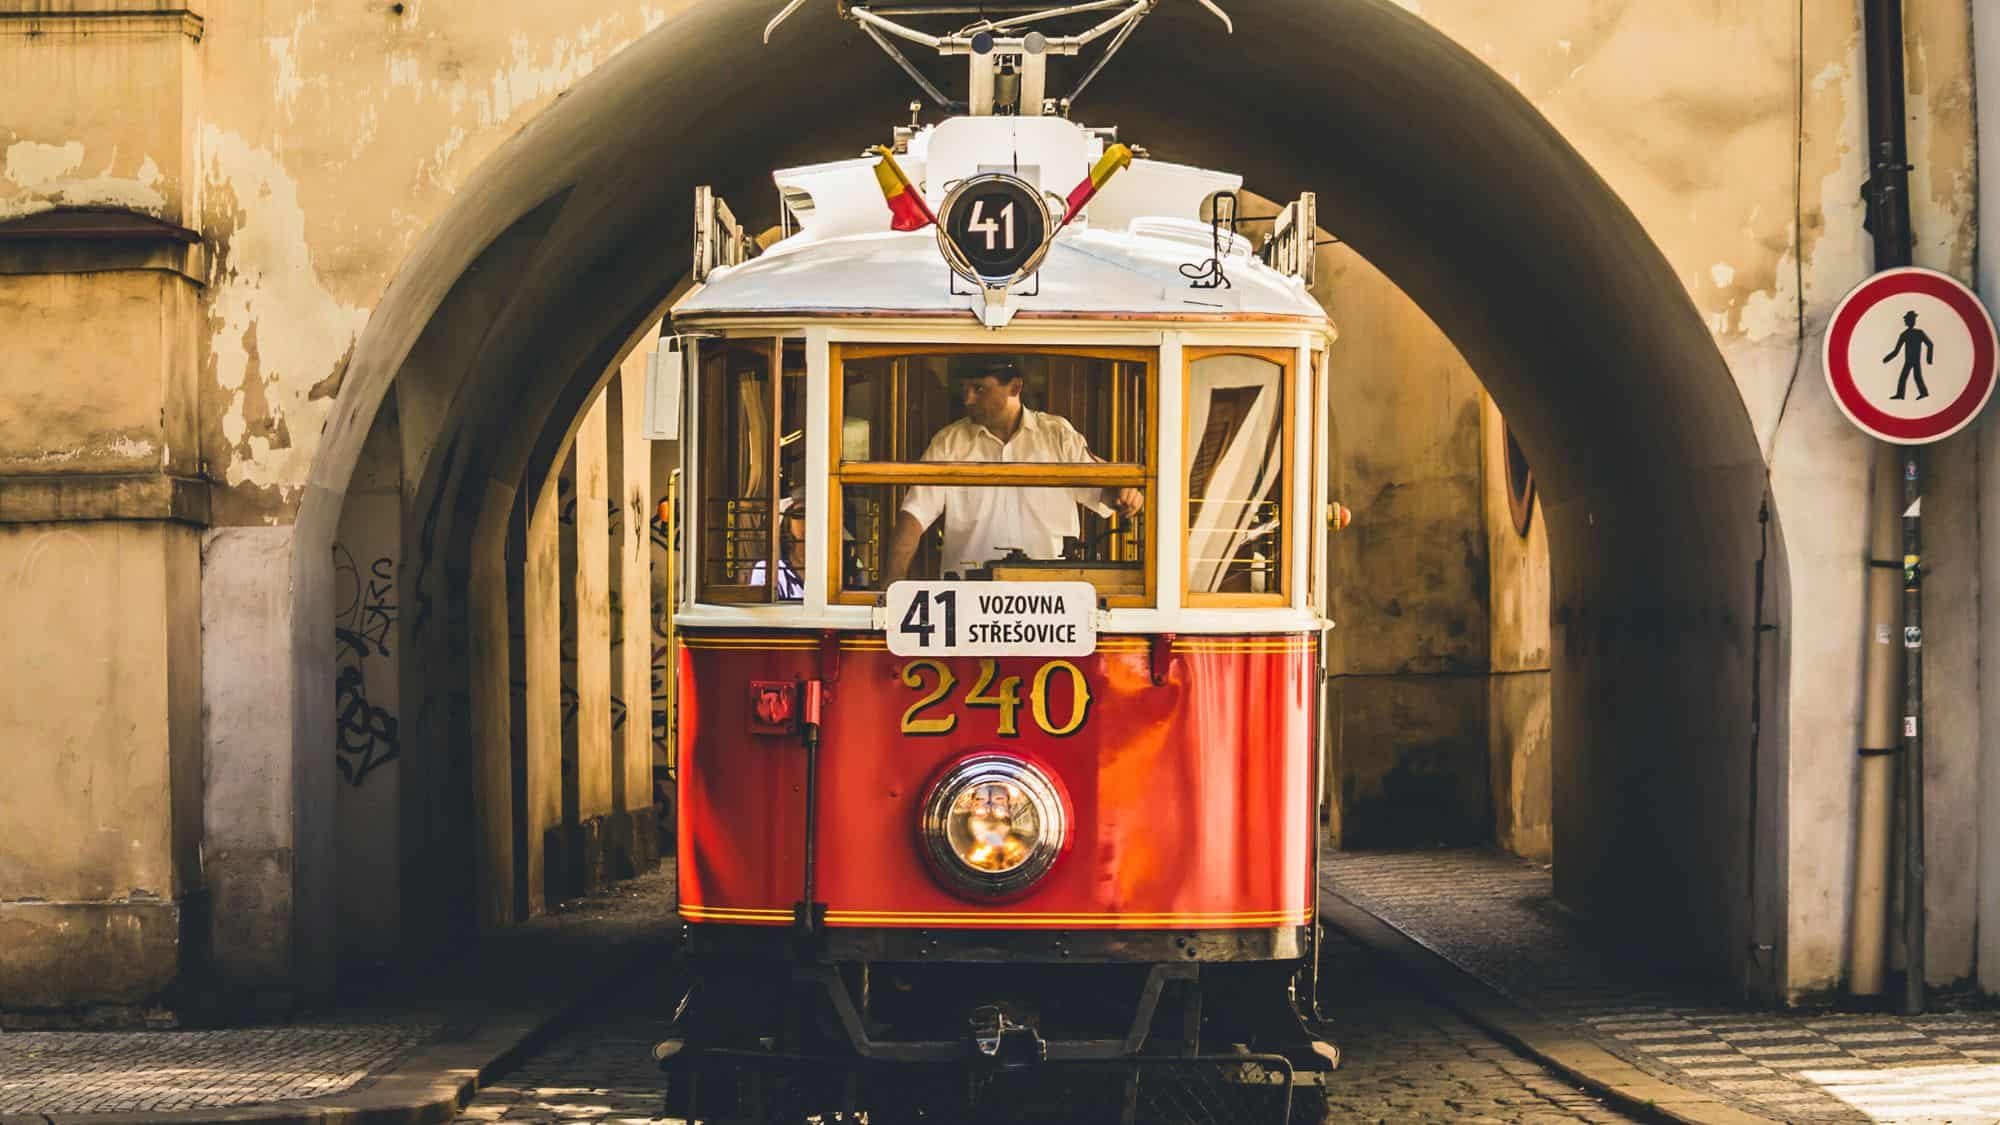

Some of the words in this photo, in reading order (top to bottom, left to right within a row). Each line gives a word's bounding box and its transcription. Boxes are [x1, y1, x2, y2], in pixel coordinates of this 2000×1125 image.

[967, 200, 1015, 249] 41
[900, 590, 957, 647] 41
[978, 595, 1065, 615] VOZOVNA
[968, 620, 1076, 643] STŘEŠOVICE
[901, 658, 1091, 737] 240
